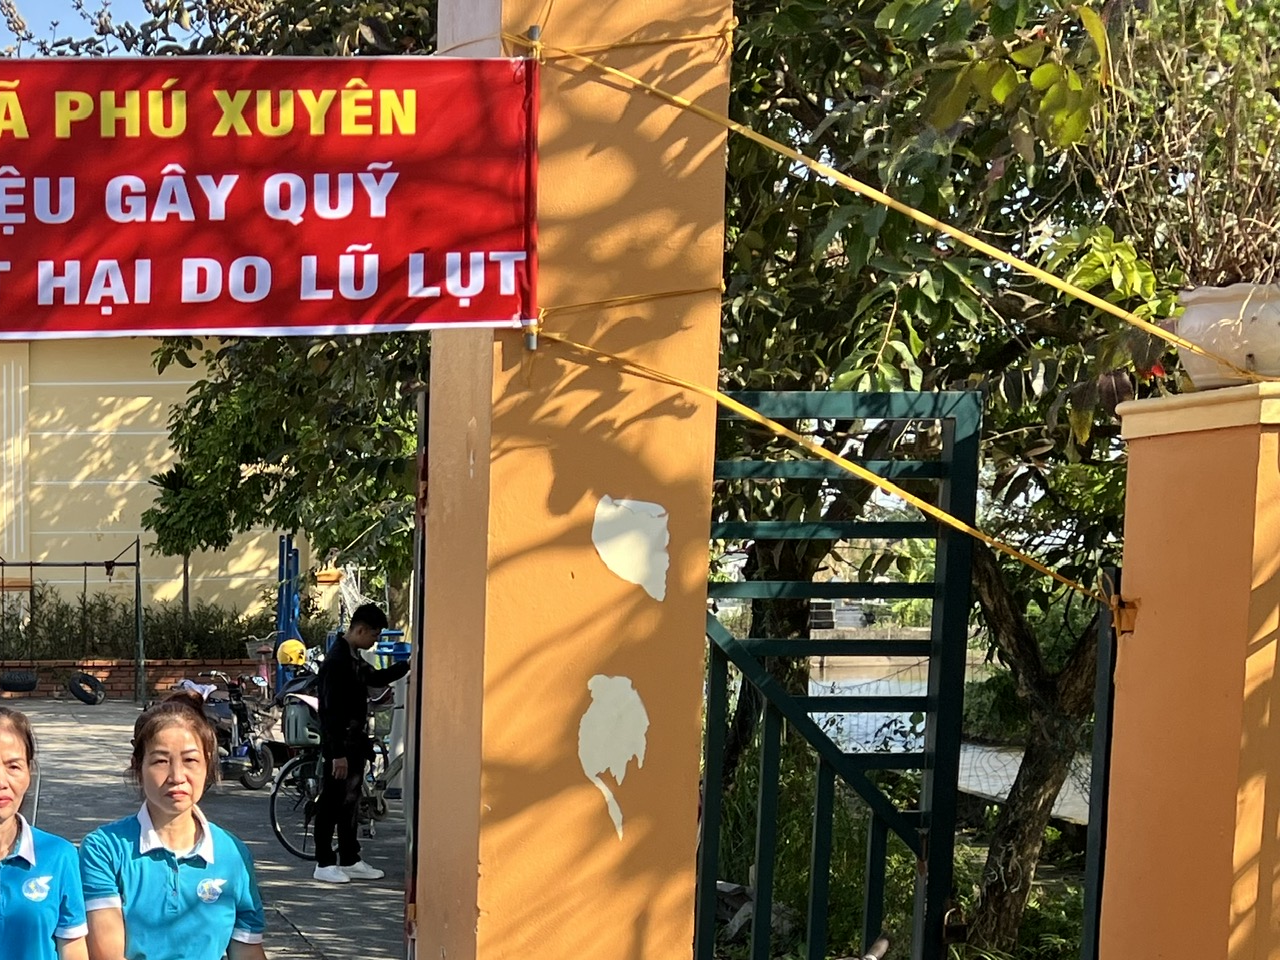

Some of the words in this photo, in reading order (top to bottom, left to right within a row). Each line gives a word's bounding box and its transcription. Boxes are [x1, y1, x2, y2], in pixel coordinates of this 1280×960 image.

[55, 78, 187, 138] PHÚ
[212, 77, 417, 137] XUYÊN
[105, 163, 239, 223] GÂY
[263, 160, 400, 226] QUỸ
[37, 259, 151, 315] HẠI
[181, 256, 271, 303] DO
[300, 243, 379, 300] LŨ
[408, 251, 527, 307] LỤT
